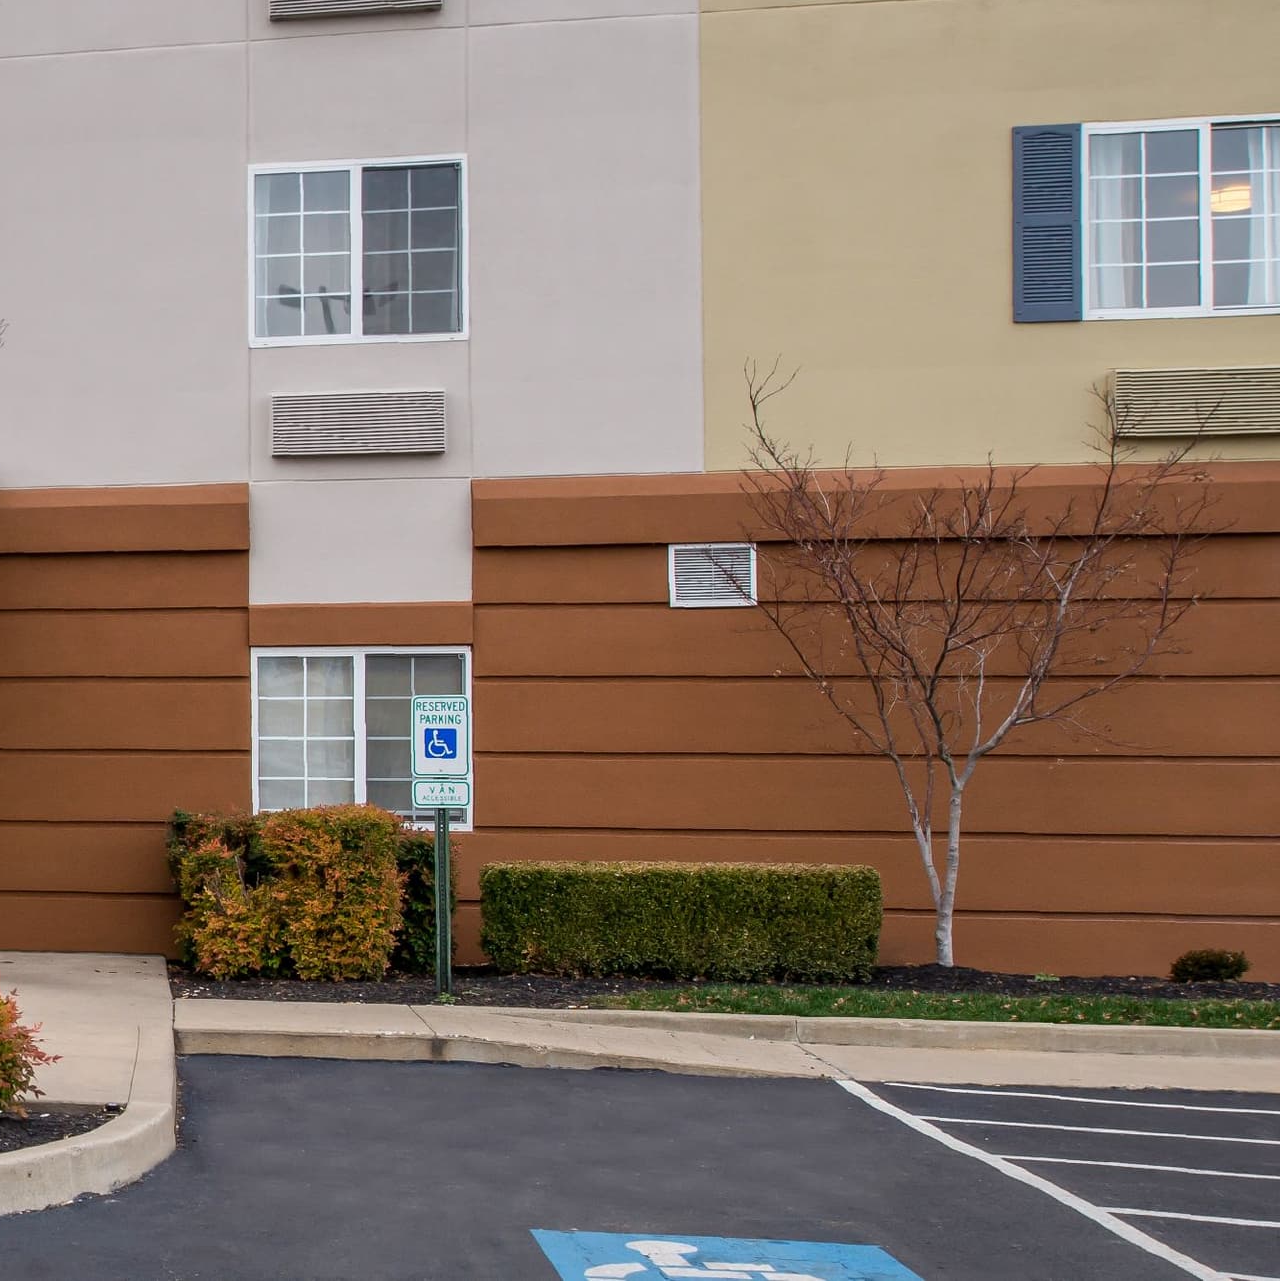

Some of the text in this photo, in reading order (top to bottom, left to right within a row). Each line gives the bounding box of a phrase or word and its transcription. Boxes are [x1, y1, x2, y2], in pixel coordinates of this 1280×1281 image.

[416, 701, 465, 711] RESERVED
[419, 714, 462, 724] PARKING
[429, 786, 455, 794] VAN
